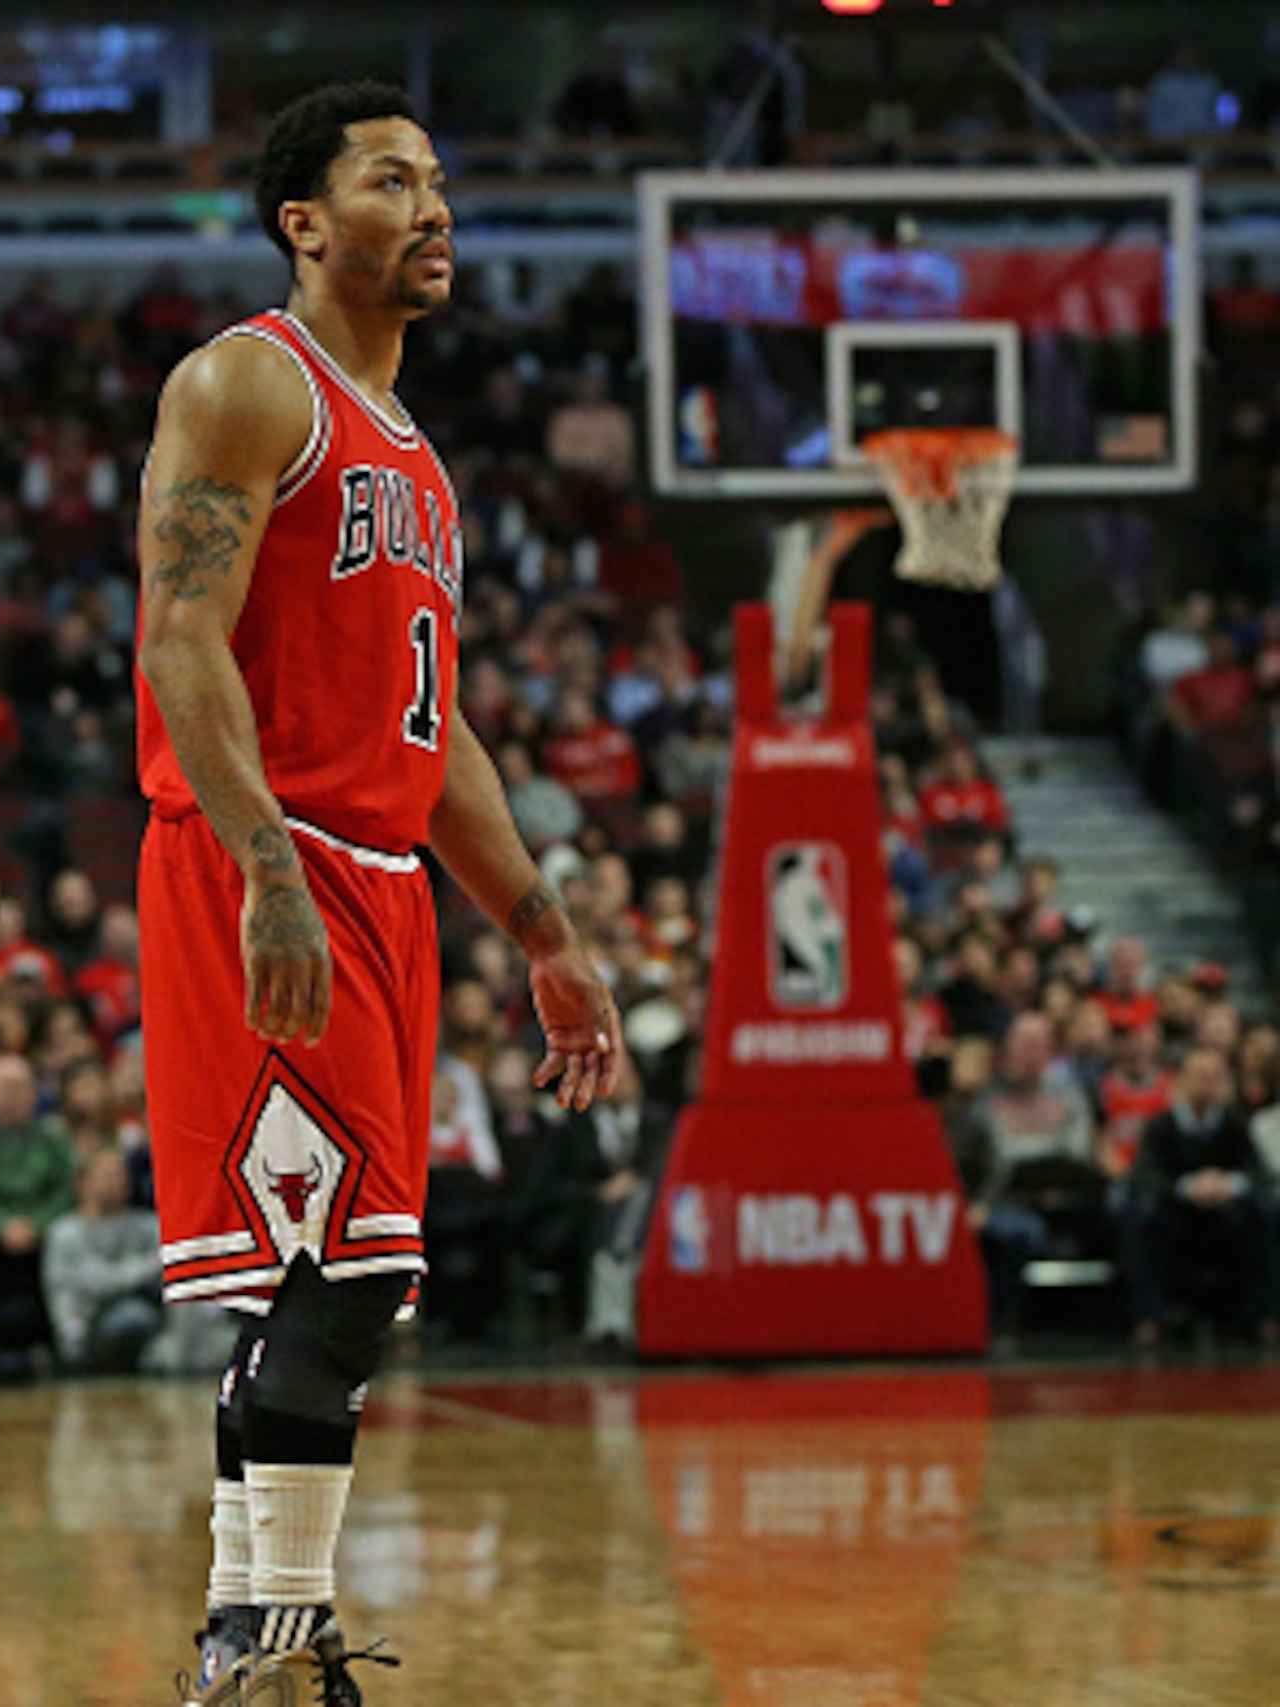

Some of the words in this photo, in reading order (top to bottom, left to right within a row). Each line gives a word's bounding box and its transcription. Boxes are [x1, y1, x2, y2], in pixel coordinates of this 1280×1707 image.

[403, 606, 441, 752] 1
[737, 1194, 866, 1265] NBA
[873, 1192, 955, 1263] TV
